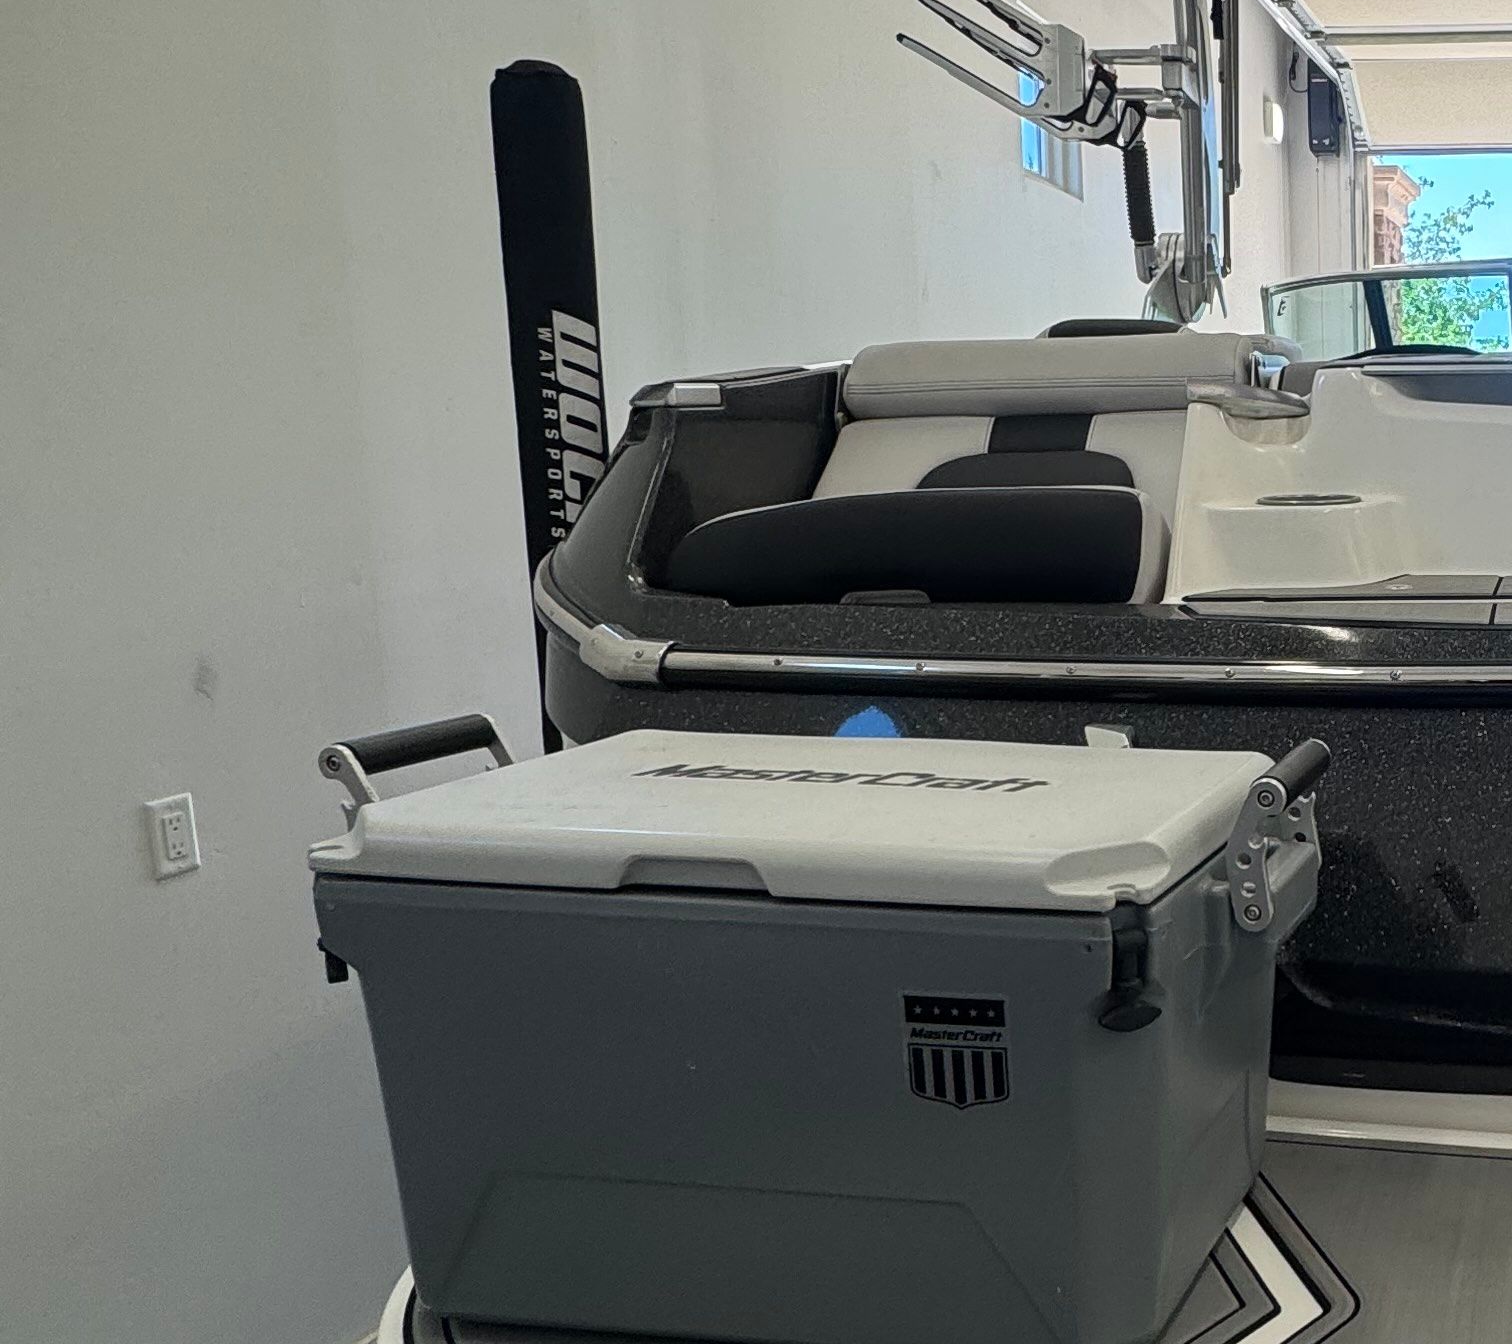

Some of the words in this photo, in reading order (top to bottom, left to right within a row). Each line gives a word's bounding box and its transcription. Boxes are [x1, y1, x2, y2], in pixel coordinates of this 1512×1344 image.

[536, 326, 566, 539] WATERSPORTS
[551, 309, 605, 523] WOL
[632, 764, 1048, 793] MasterCraft
[910, 1027, 1003, 1042] MasterCraft
